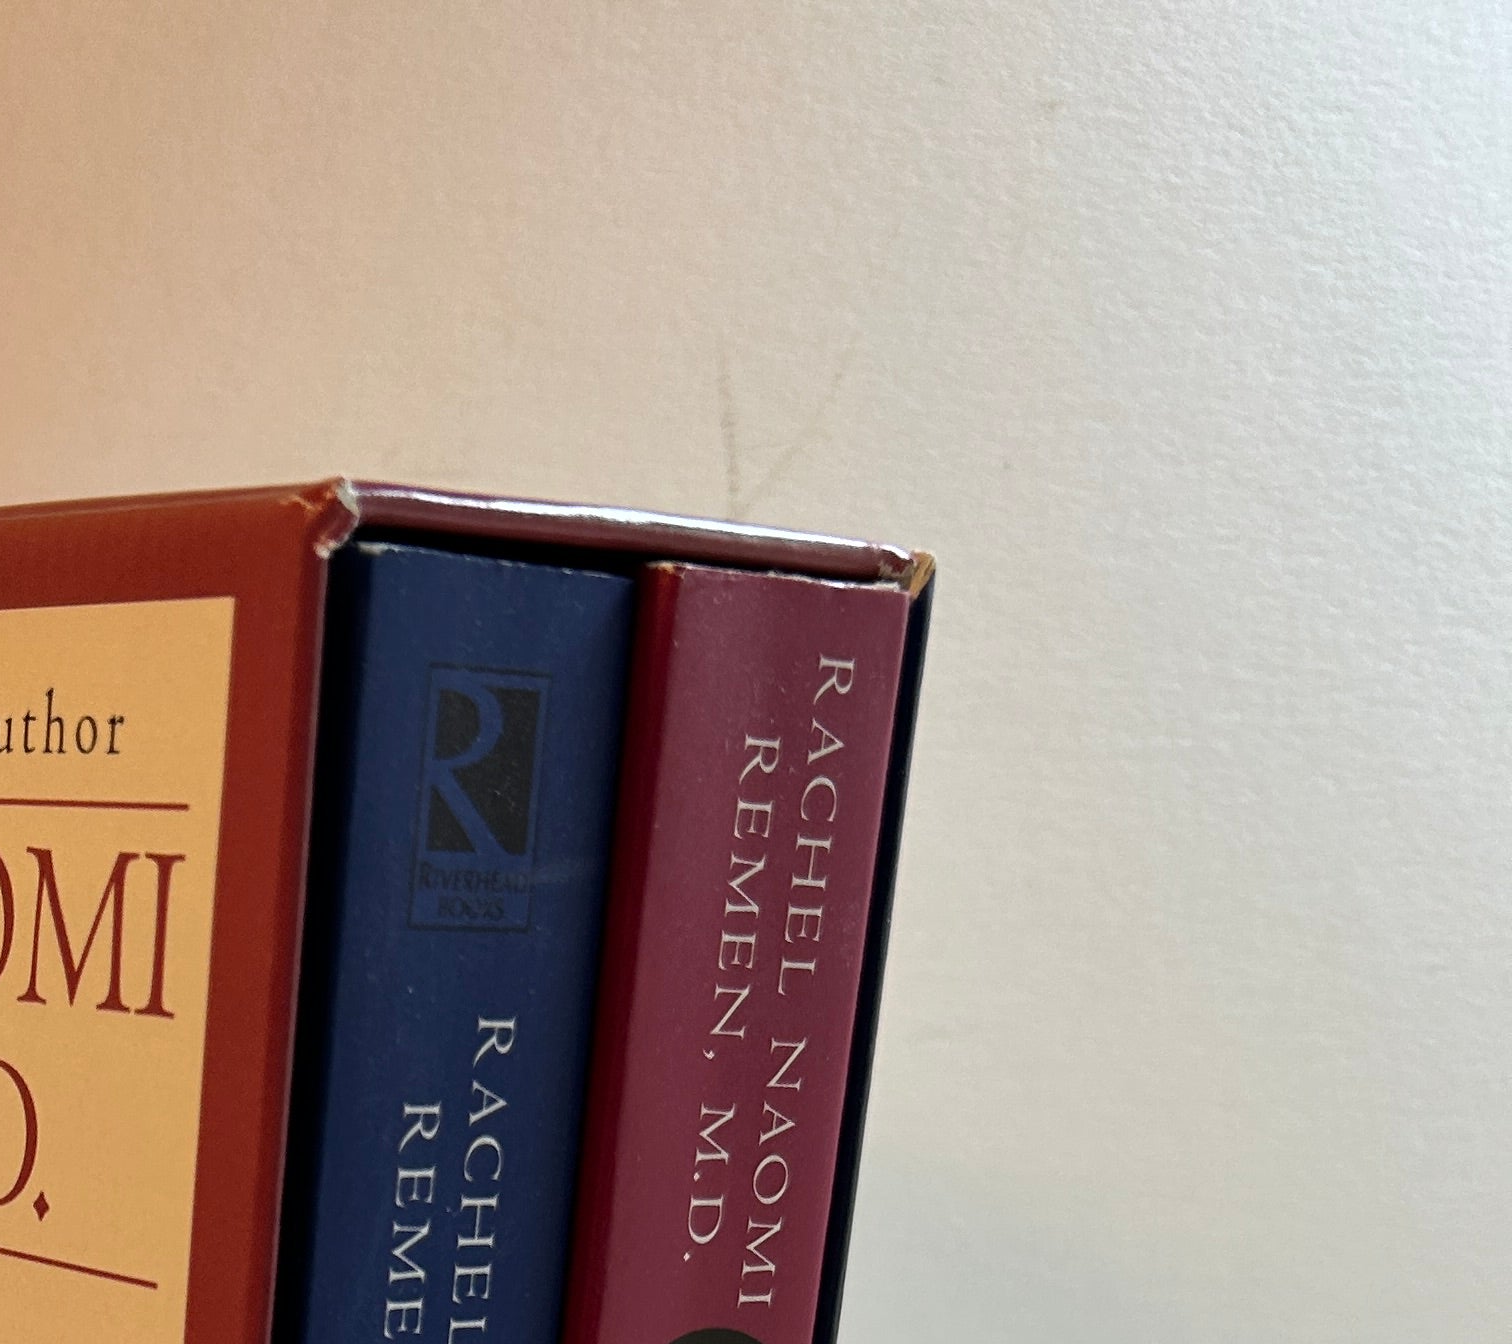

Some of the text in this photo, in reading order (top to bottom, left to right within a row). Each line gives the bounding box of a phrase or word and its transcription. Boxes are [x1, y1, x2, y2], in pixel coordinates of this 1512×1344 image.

[683, 734, 781, 1261] REMEN, M.D.
[738, 654, 855, 1308] RACHEL NAOMI
